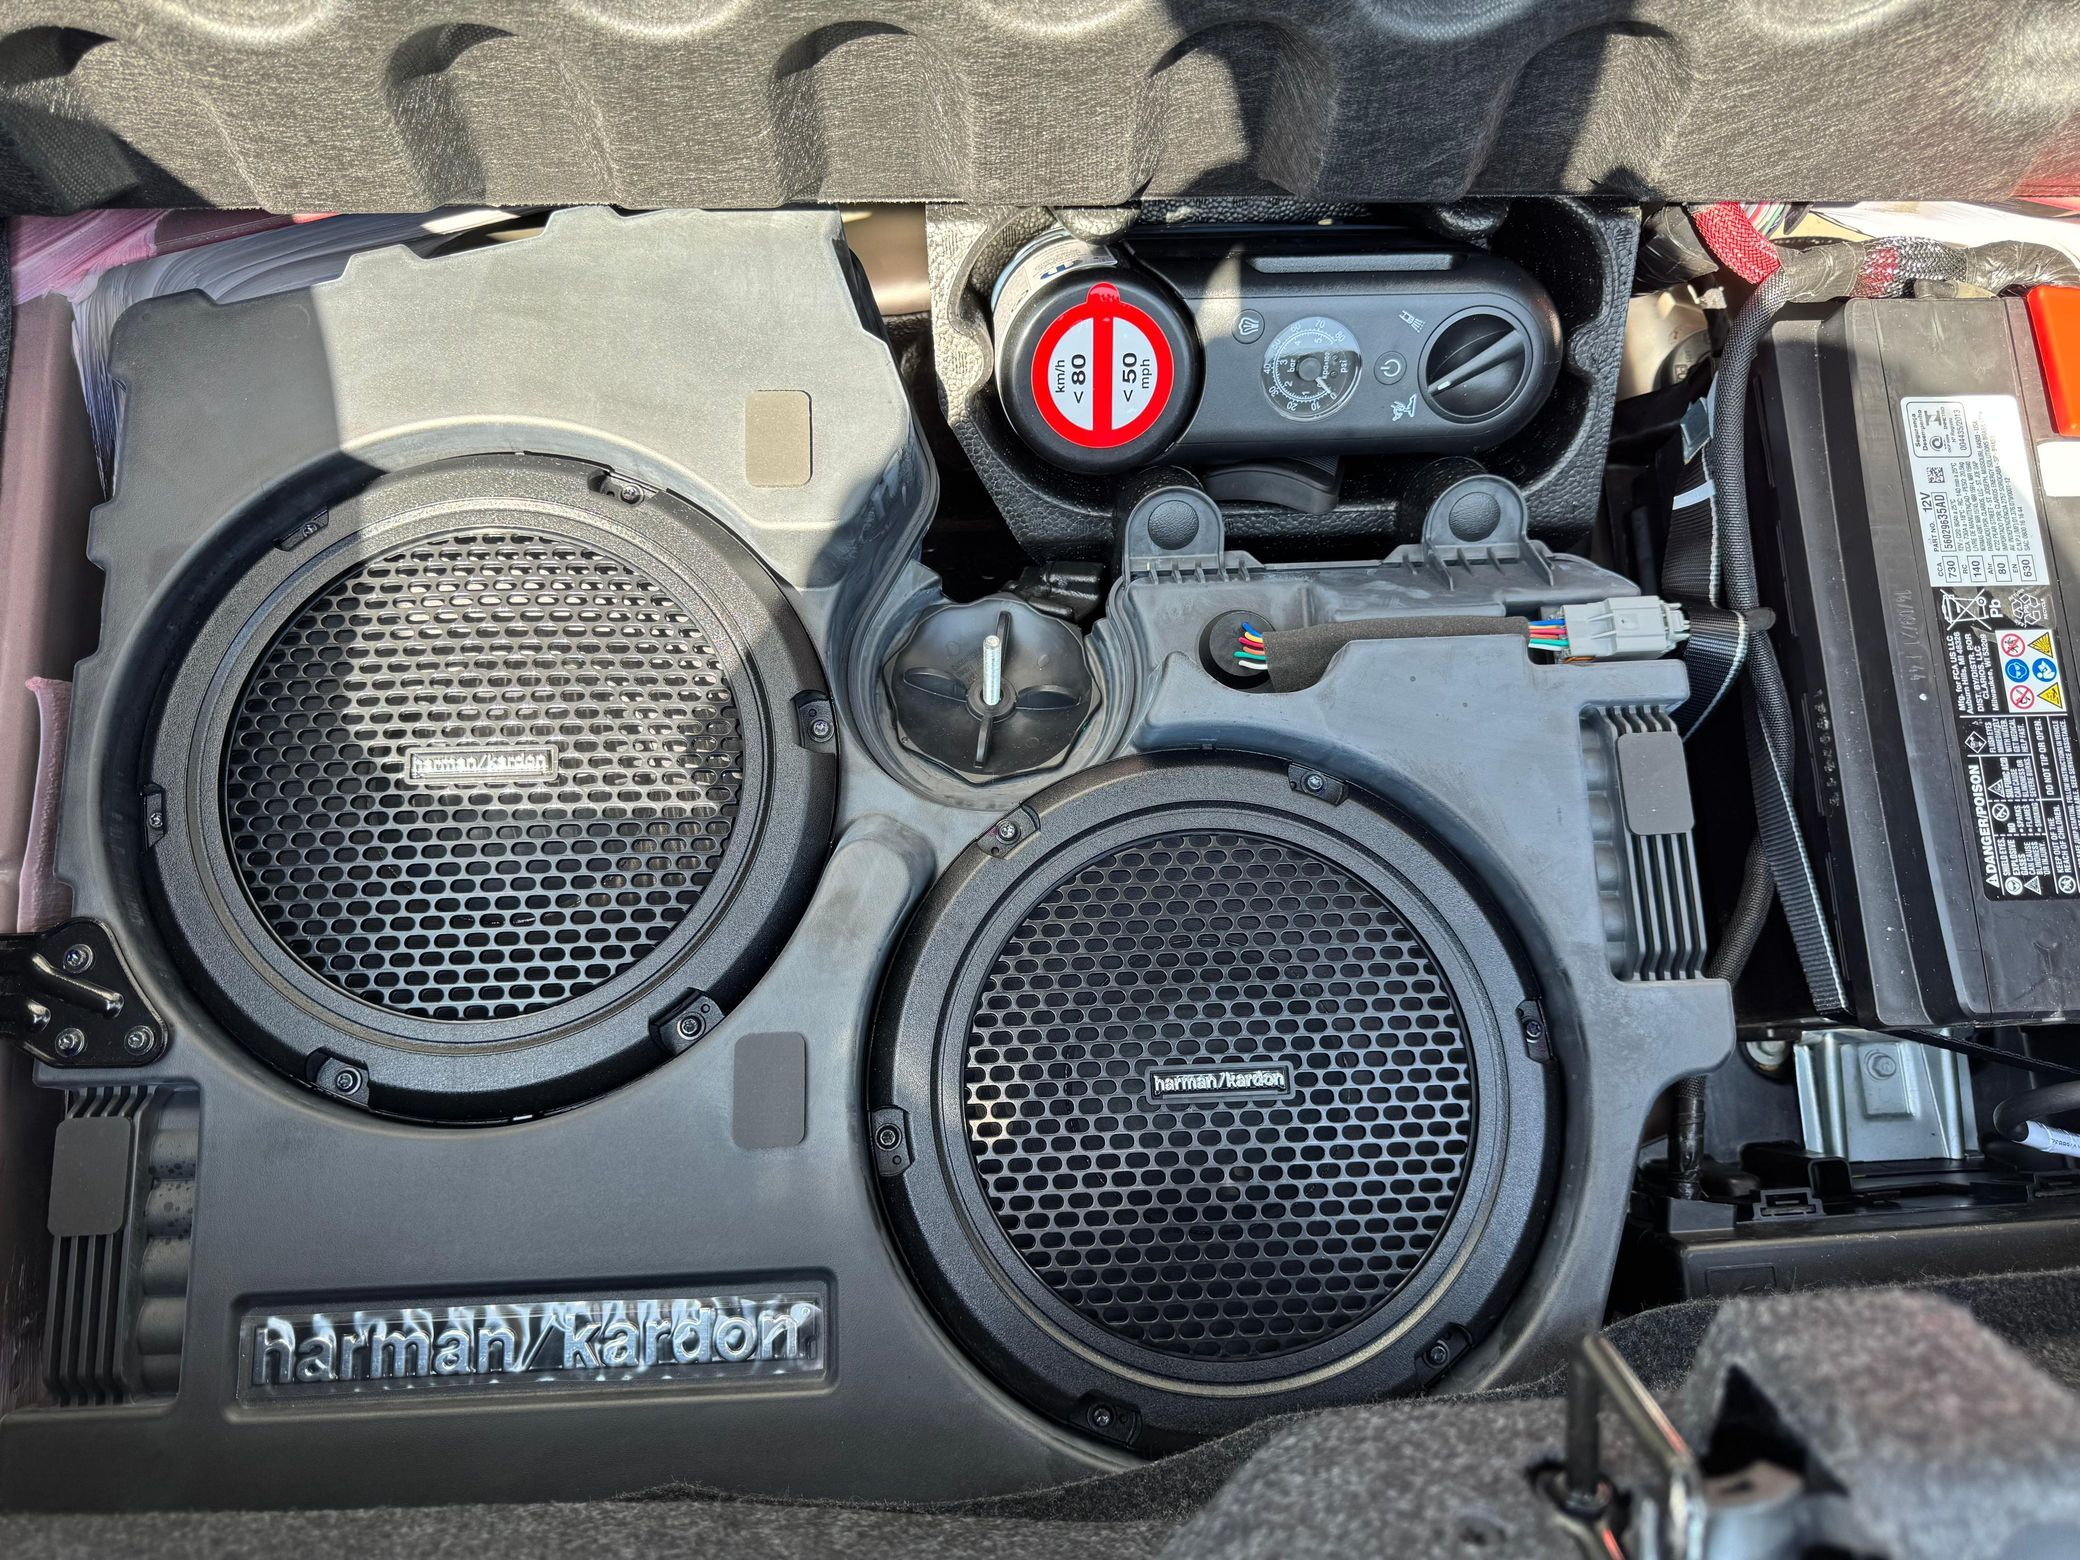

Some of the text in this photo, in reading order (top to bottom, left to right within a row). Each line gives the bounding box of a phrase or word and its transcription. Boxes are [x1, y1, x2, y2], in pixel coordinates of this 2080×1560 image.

[1315, 319, 1325, 328] 70
[1055, 360, 1065, 393] km/h
[1071, 354, 1086, 385] 80
[1122, 353, 1137, 384] 50
[1140, 359, 1152, 389] mph
[1287, 358, 1296, 373] bar
[1339, 360, 1348, 373] psi
[1953, 409, 1967, 450] 004435/2013
[1995, 466, 2004, 491] SOROCABA
[1919, 491, 1932, 512] 12V
[1982, 441, 2008, 550] IMPORTADO CLARIOS ENERGY SOLUTIONS
[1933, 495, 1952, 548] 56029635AD
[1987, 508, 1995, 524] STREET
[1931, 534, 1939, 551] PART
[1984, 528, 1993, 551] FABRICADO
[1990, 526, 1998, 538] PEAR
[1936, 562, 1944, 576] CCA
[1946, 560, 1957, 577] 730
[1961, 564, 1968, 573] RC
[1971, 560, 1981, 576] 140
[1997, 562, 2006, 574] 80
[2011, 564, 2018, 572] EN
[2021, 559, 2032, 576] 630
[1987, 599, 2003, 617] Pb
[2040, 598, 2048, 619] RECYCLE
[1964, 633, 1973, 650] POR
[1945, 635, 1967, 710] Mfg. for FCA US LLC
[1953, 631, 1974, 713] Auburn Hills, MI 48326
[1967, 651, 1981, 690] BY/DISTR.
[1974, 645, 1990, 699] CLARIOS, LLC
[1979, 634, 2000, 710] Milwaukee, WI 53209
[1984, 721, 1996, 752] FLUSH EYES
[1992, 718, 2004, 752] IMMEDIATELY
[2007, 718, 2020, 752] GET MEDICAL
[2017, 723, 2028, 752] HELP FAST.
[2051, 720, 2061, 739] VEHICLE
[2003, 738, 2012, 752] WITH
[2033, 718, 2054, 794] DO NOT TIP OR OPEN.
[2059, 719, 2078, 788] SEEK SERVICE ASSISTANCE.
[1999, 757, 2014, 797] SULFURIC ACID
[2056, 747, 2069, 782] INSTRUCTIONS
[2009, 768, 2021, 797] CAN CAUSE
[2017, 768, 2029, 796] BLINDNESS
[2026, 777, 2036, 796] SEVERE
[2063, 783, 2073, 802] FOLLOW
[1969, 765, 1996, 873] DANGER/POISON
[2006, 822, 2016, 832] NO
[2013, 805, 2024, 827] SPARKS
[2022, 804, 2033, 826] FLAMES
[2031, 802, 2042, 826] SMOKING
[2047, 817, 2064, 872] KEEP OUT OF THE
[2052, 804, 2071, 872] REACH OF CHILDREN.
[1996, 837, 2010, 875] SHIELD EYES.
[2006, 839, 2020, 875] EXPLOSIVE
[2017, 853, 2028, 875] GASES
[2023, 841, 2036, 874] CAN CAUSE
[2031, 841, 2043, 874] BLINDNESS
[2038, 841, 2050, 874] OR INJURY.
[1154, 1071, 1286, 1092] harman/kardon
